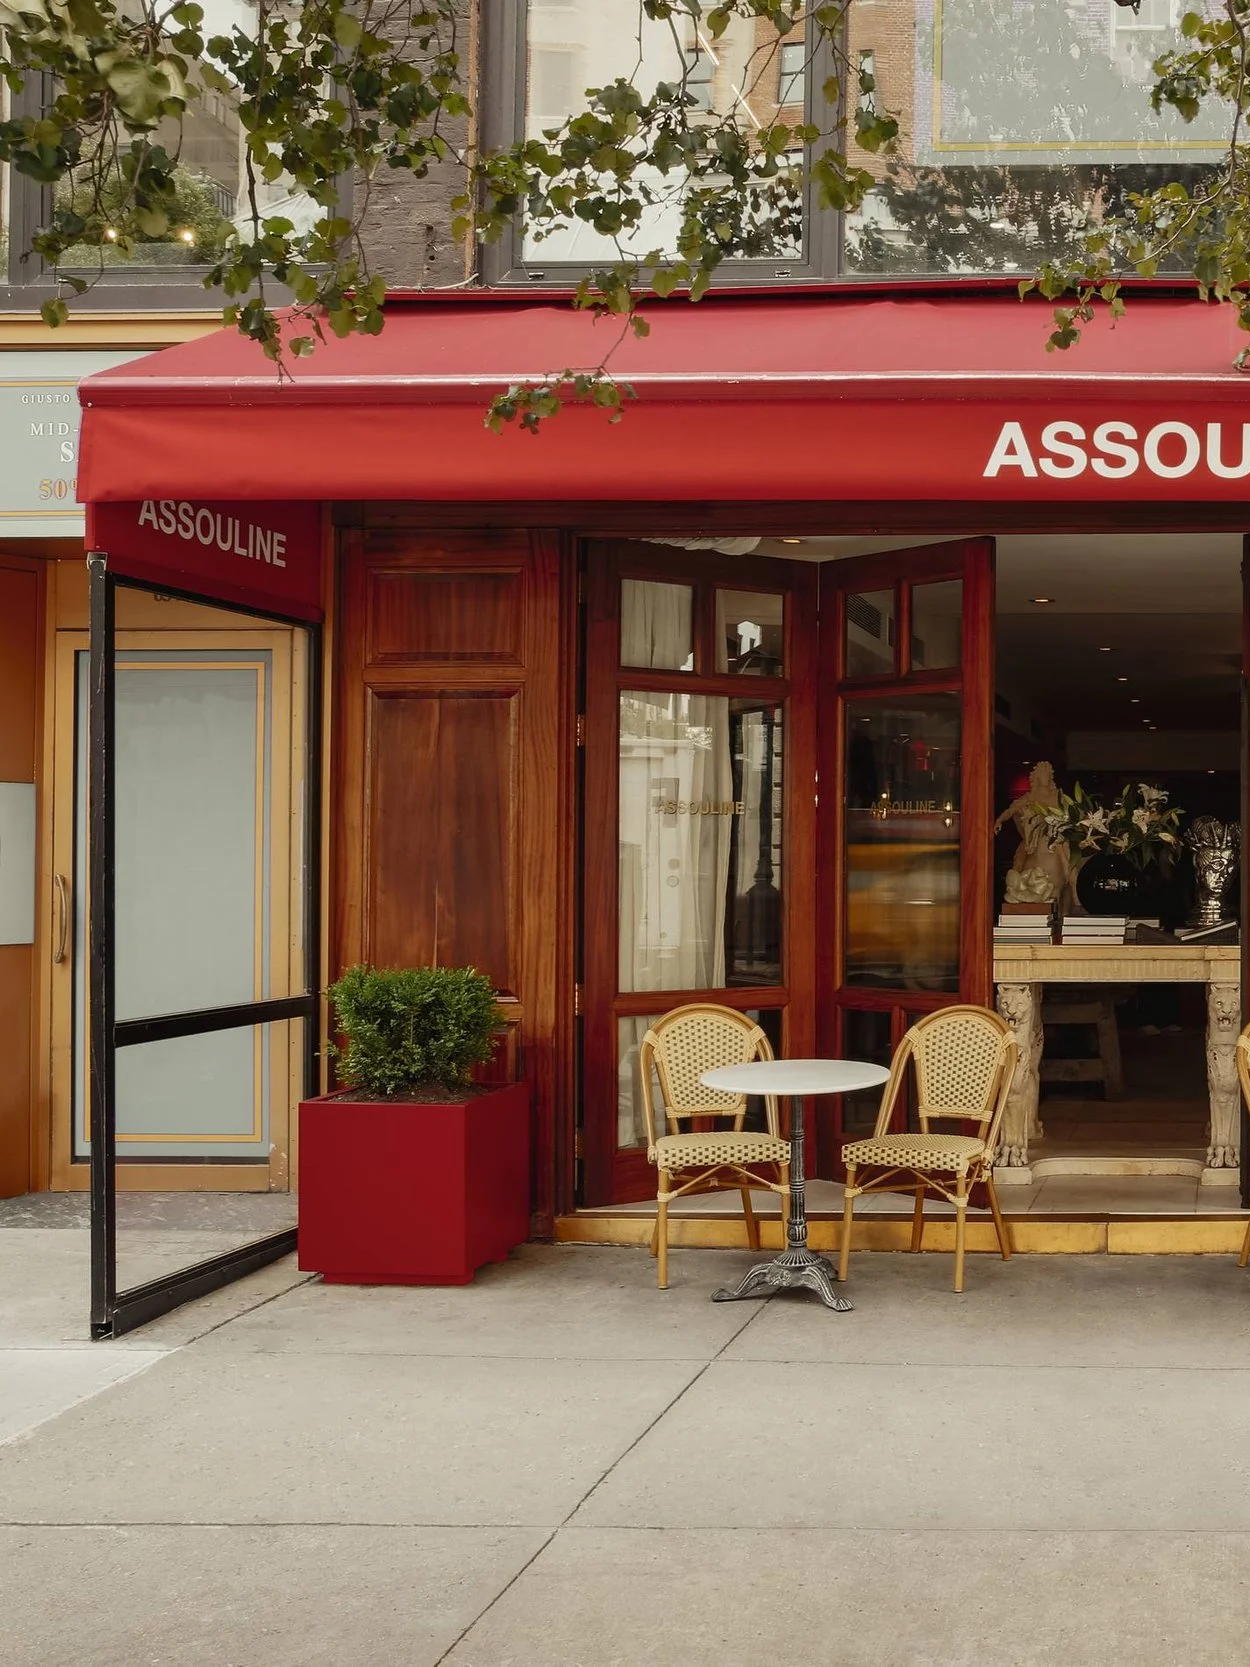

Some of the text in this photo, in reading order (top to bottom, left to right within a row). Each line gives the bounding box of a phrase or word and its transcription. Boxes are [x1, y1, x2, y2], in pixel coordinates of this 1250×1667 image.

[21, 394, 70, 404] GIUSTO
[60, 441, 79, 463] S
[138, 500, 287, 568] ASSOULINE
[654, 801, 745, 815] ASSOULINE
